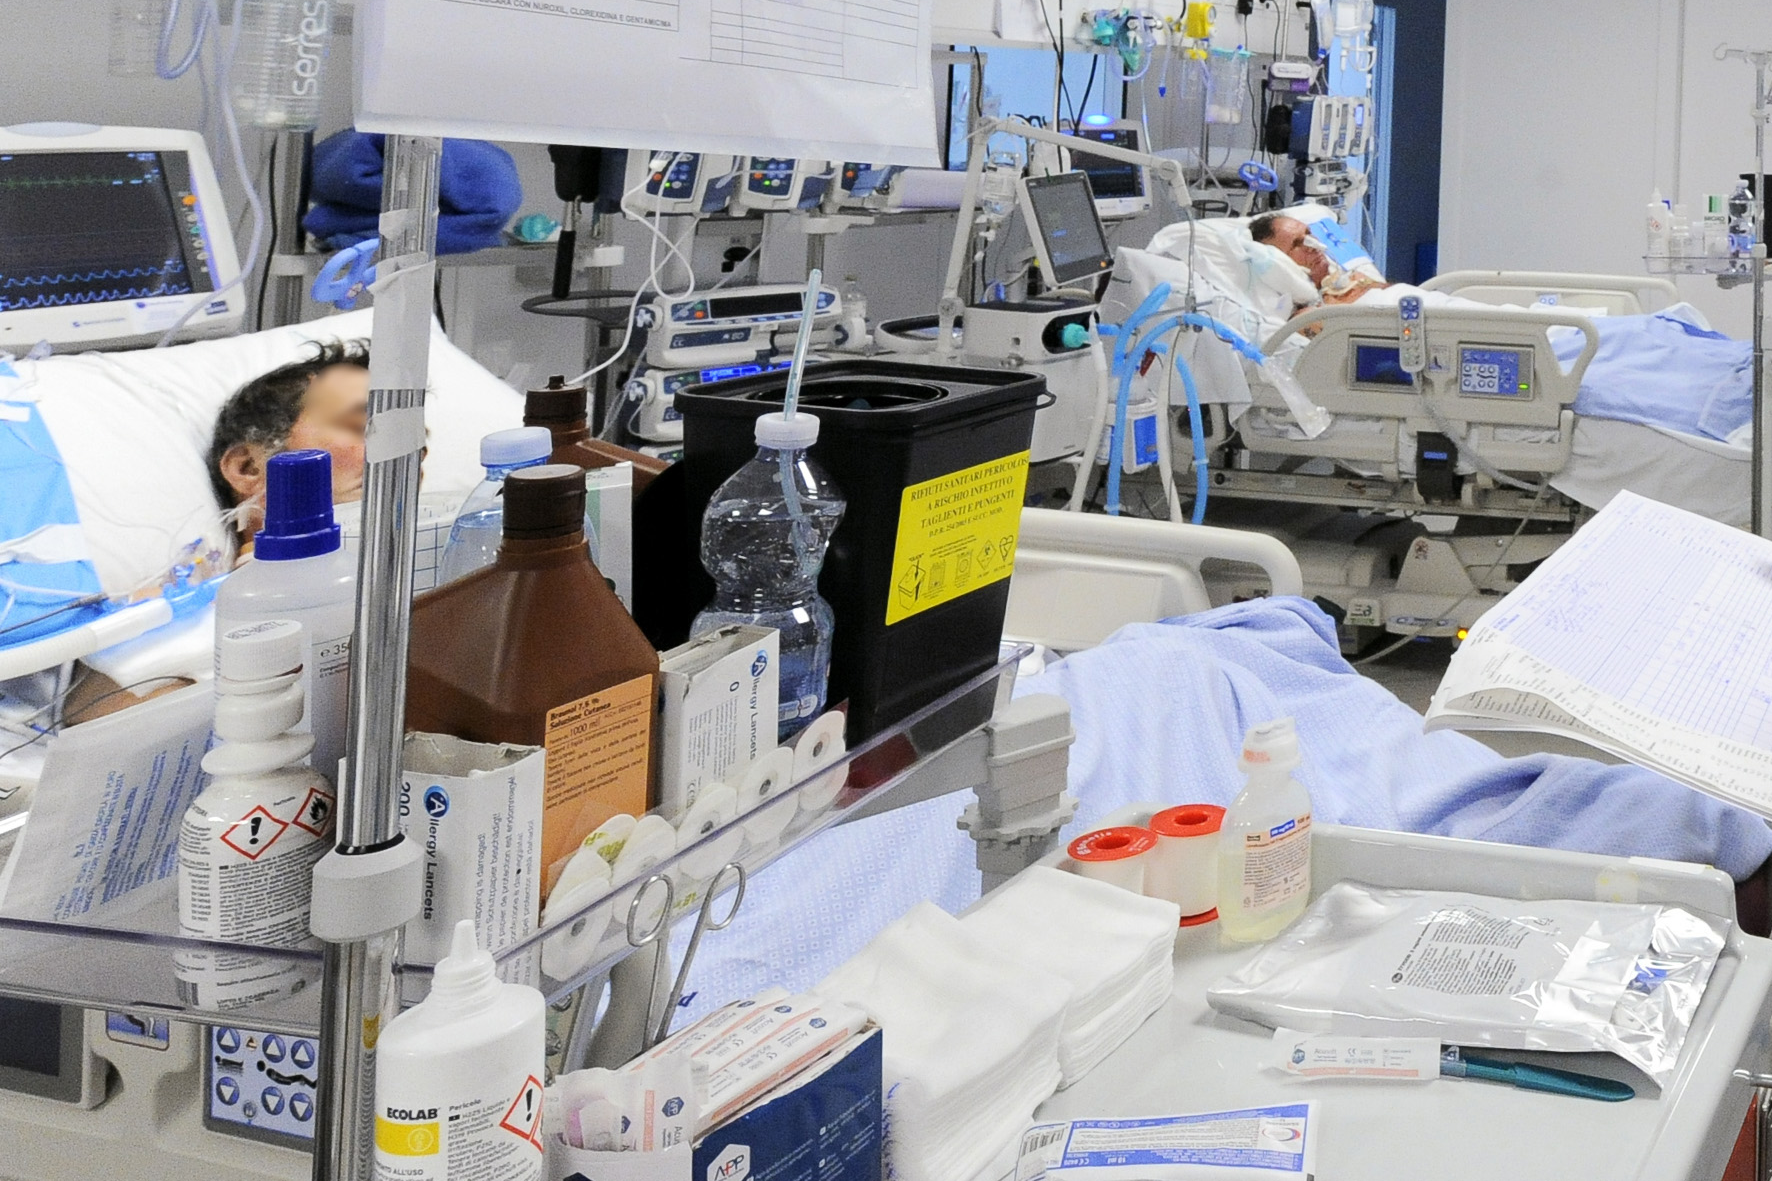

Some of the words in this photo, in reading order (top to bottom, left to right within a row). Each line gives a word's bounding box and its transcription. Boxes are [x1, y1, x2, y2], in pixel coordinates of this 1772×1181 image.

[569, 5, 617, 22] CLOREXIDINA
[292, 0, 328, 96] serres
[911, 484, 944, 502] RIFIUTI
[944, 471, 983, 492] SANITARI
[927, 501, 932, 510] A
[935, 489, 969, 509] RISCHIO
[971, 475, 1013, 497] INFETTIVO
[920, 507, 967, 529] TAGLIENTI
[974, 489, 1015, 512] PUNGENTI
[750, 663, 764, 710] Allergy
[550, 705, 576, 720] Braunol
[550, 712, 581, 729] Soluzione
[583, 701, 610, 716] Cutanea
[570, 722, 587, 736] 1000
[750, 712, 758, 760] Lancets
[426, 795, 446, 859] Allergy
[473, 833, 488, 877] damaged!
[499, 849, 512, 893] protection
[423, 861, 437, 921] Lancets
[471, 888, 487, 930] wrapping
[483, 865, 500, 924] Schutzpapier
[387, 1107, 438, 1120] ECOLAB
[449, 1099, 482, 1111] Pericolo
[448, 1155, 470, 1164] Tenere
